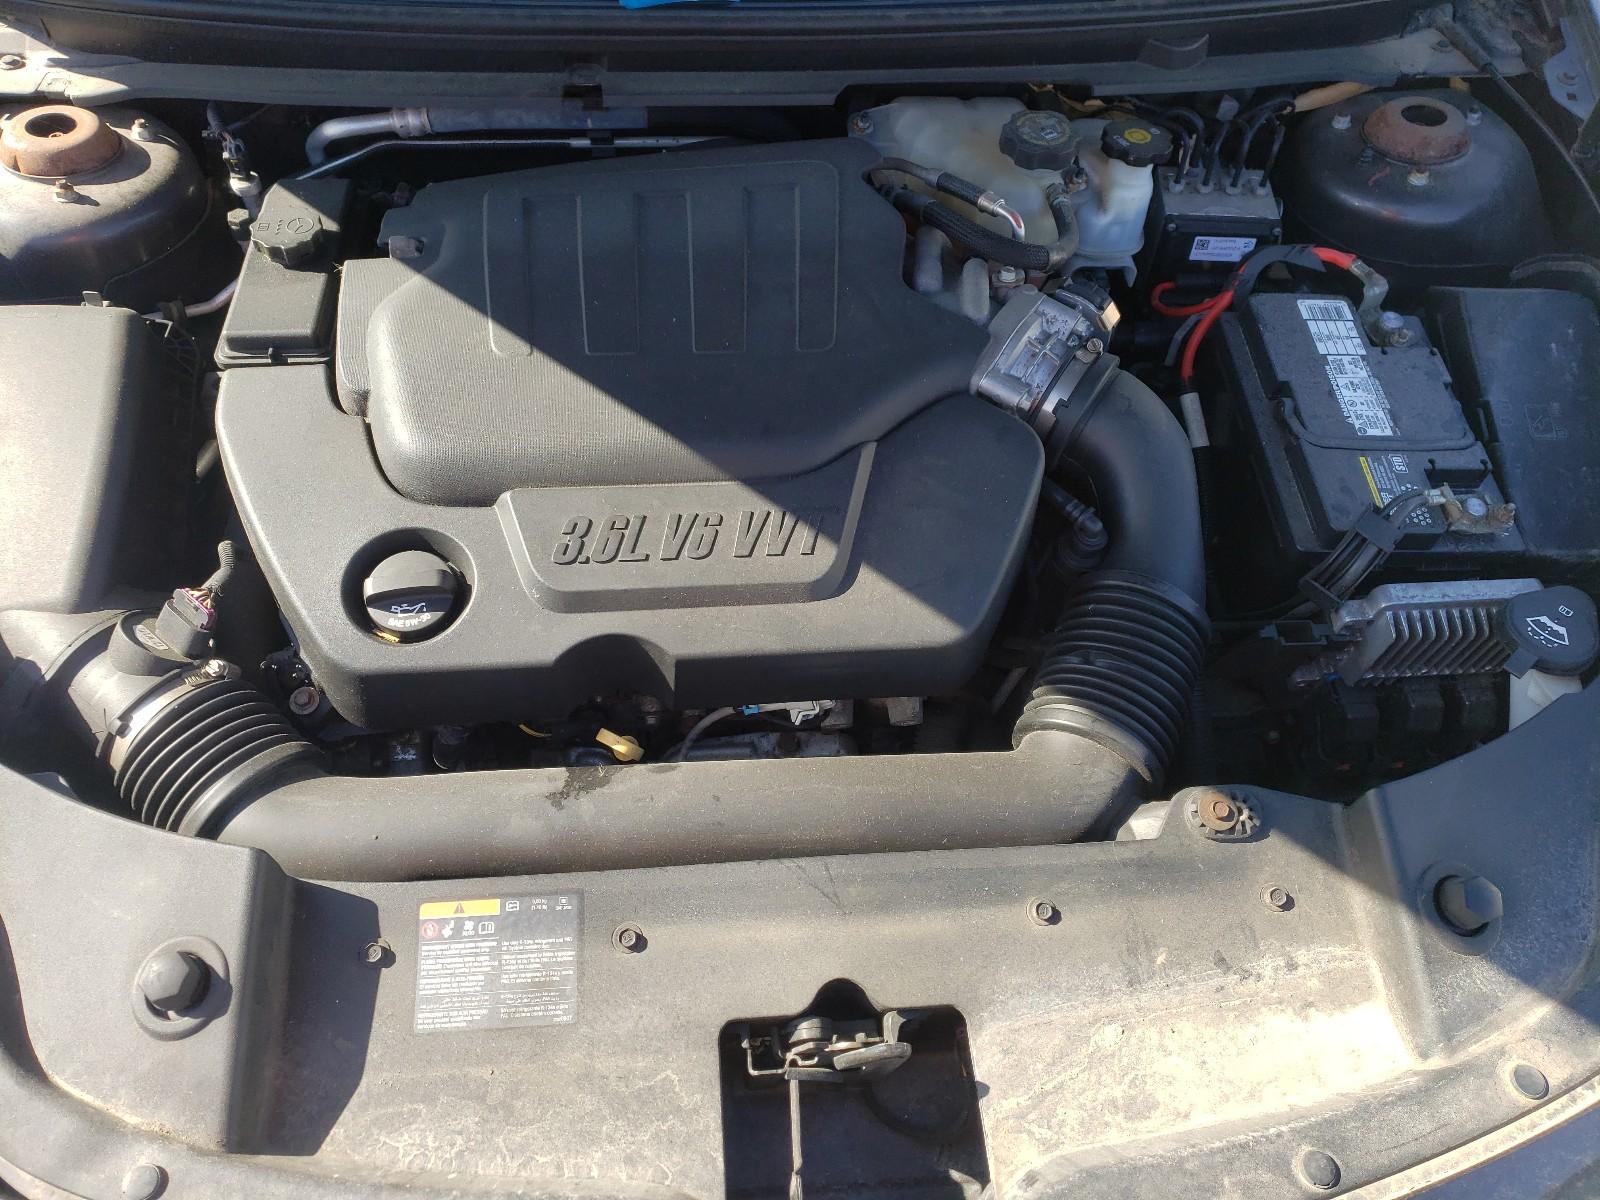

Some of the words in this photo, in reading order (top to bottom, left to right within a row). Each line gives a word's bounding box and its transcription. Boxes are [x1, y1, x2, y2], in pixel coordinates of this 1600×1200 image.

[551, 514, 650, 566] 3.6L
[658, 511, 723, 562] V6
[732, 508, 838, 560] VVT
